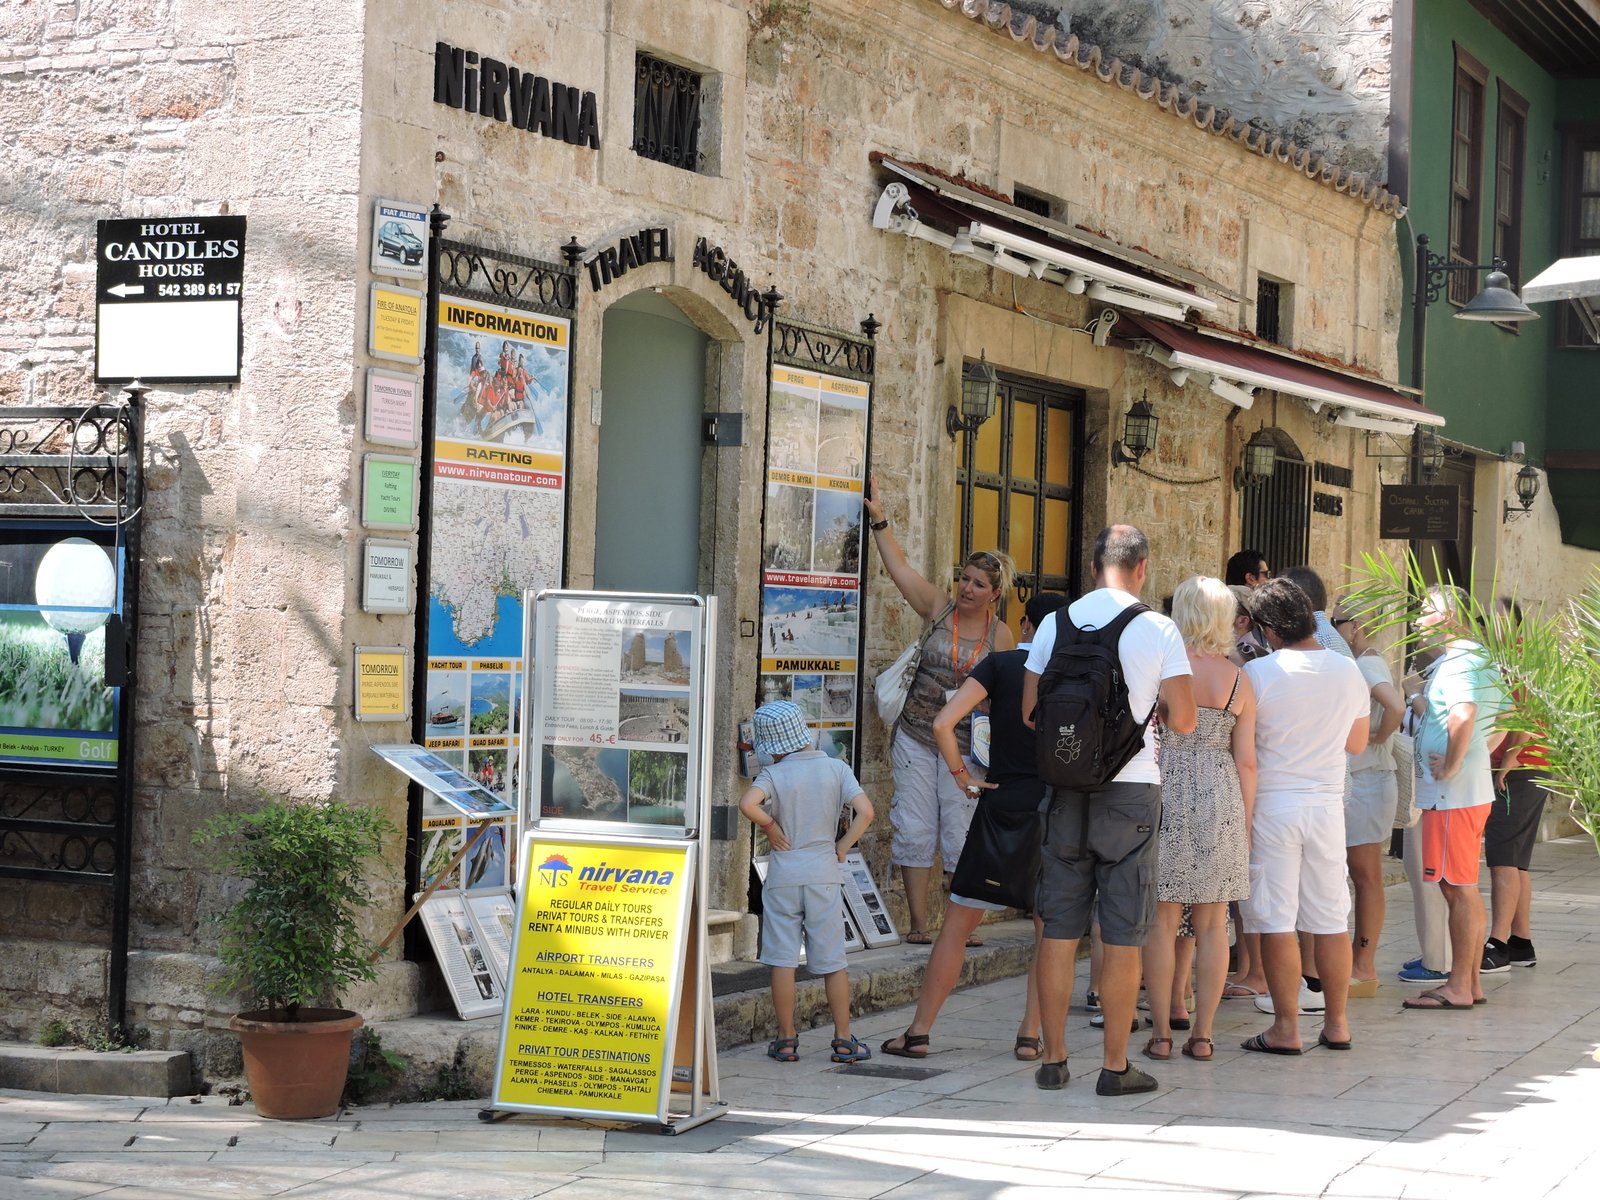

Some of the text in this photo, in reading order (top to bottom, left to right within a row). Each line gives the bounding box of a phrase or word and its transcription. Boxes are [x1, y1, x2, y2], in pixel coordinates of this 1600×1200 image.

[383, 208, 398, 217] FIAT
[141, 223, 205, 236] HOTEL
[105, 240, 239, 261] CANDLES
[139, 264, 204, 277] HOUSE
[584, 227, 772, 334] TRAVEL AGENCY
[159, 283, 240, 296] 542 389 61 57
[377, 300, 387, 309] FIRE
[395, 304, 417, 314] ANATOLIA
[447, 307, 558, 341] INFORMATION
[787, 374, 804, 384] PERGE
[831, 382, 859, 393] ASPENDOS
[467, 448, 532, 465] RAFTING
[438, 465, 557, 486] www.nirvanatour.com
[771, 472, 789, 482] DEMRE
[797, 475, 812, 484] MYRA
[829, 480, 850, 489] KEKOVA
[371, 556, 404, 567] TOMORROW
[766, 574, 855, 586] www.travelantalya.com
[616, 618, 664, 626] WATERFALLS
[361, 664, 398, 673] TOMORROW
[776, 660, 840, 671] PAMUKKALE
[80, 741, 112, 758] Golf
[543, 806, 563, 815] SIDE
[428, 819, 455, 827] AQUALAND
[578, 862, 674, 885] nirvana
[579, 882, 667, 895] Travel Service
[550, 899, 593, 910] REGULAR
[622, 904, 652, 914] TOURS
[537, 911, 567, 921] PRIVAT
[570, 913, 599, 923] TOURS
[611, 915, 663, 927] TRANSFERS
[528, 922, 669, 940] RENT A MINIBUS WITH DRIVER
[588, 955, 654, 968] TRANSFERS
[522, 967, 553, 975] ANTALYA
[560, 970, 595, 978] DALAMAN
[537, 991, 643, 1007] HOTEL TRANSFERS
[546, 1009, 571, 1017] KUNDU
[577, 1011, 600, 1019] BELEK
[515, 1015, 539, 1023] KEMER
[545, 1017, 580, 1025] TEKIROVA
[626, 1024, 661, 1032] KUMLUCA
[574, 1028, 588, 1036] KAŞ
[519, 1044, 650, 1063] PRIVAT TOUR DESTINATIONS
[509, 1060, 656, 1077] TERMESSOS WATERFALLS SAGALASSOS
[515, 1068, 539, 1076] PERGE
[544, 1071, 582, 1079] ASPENDOS
[610, 1076, 648, 1084] MANAVGAT
[543, 1079, 577, 1087] PHASELIS
[583, 1082, 616, 1090] OLYMPOS
[623, 1085, 651, 1093] TAHTALI
[537, 1087, 622, 1099] CHIEMERA PAMUKKALE
